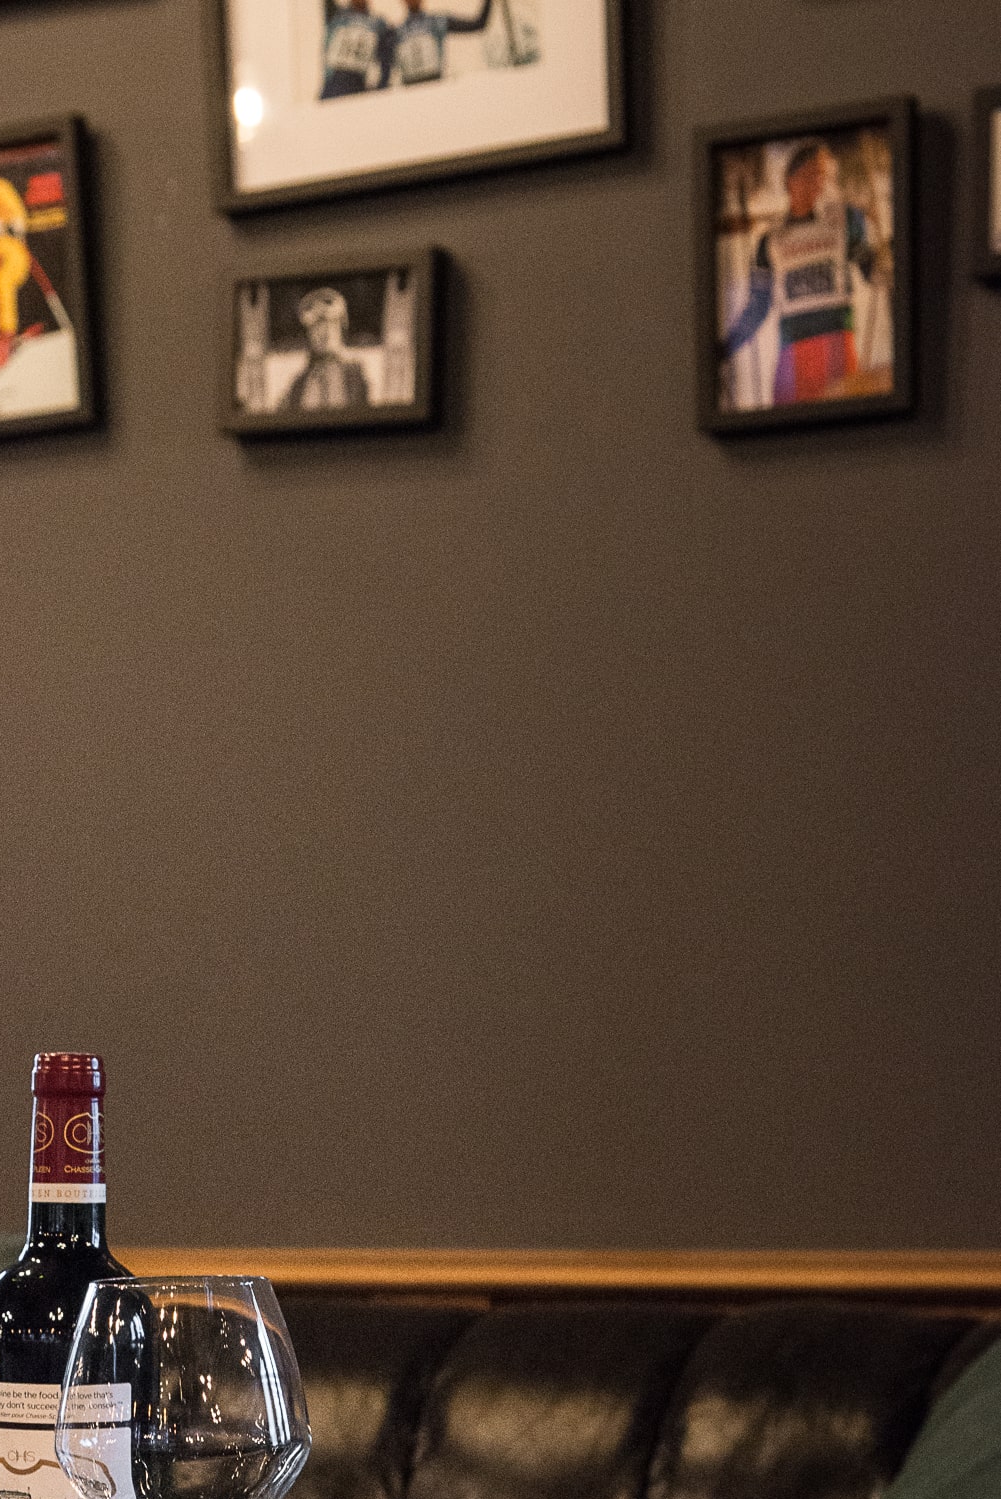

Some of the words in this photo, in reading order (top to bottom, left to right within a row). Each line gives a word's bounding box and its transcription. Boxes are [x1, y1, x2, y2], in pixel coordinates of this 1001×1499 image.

[12, 1390, 22, 1399] be
[24, 1391, 37, 1399] the
[39, 1391, 59, 1400] food
[77, 1391, 92, 1400] love
[6, 1400, 25, 1409] don't
